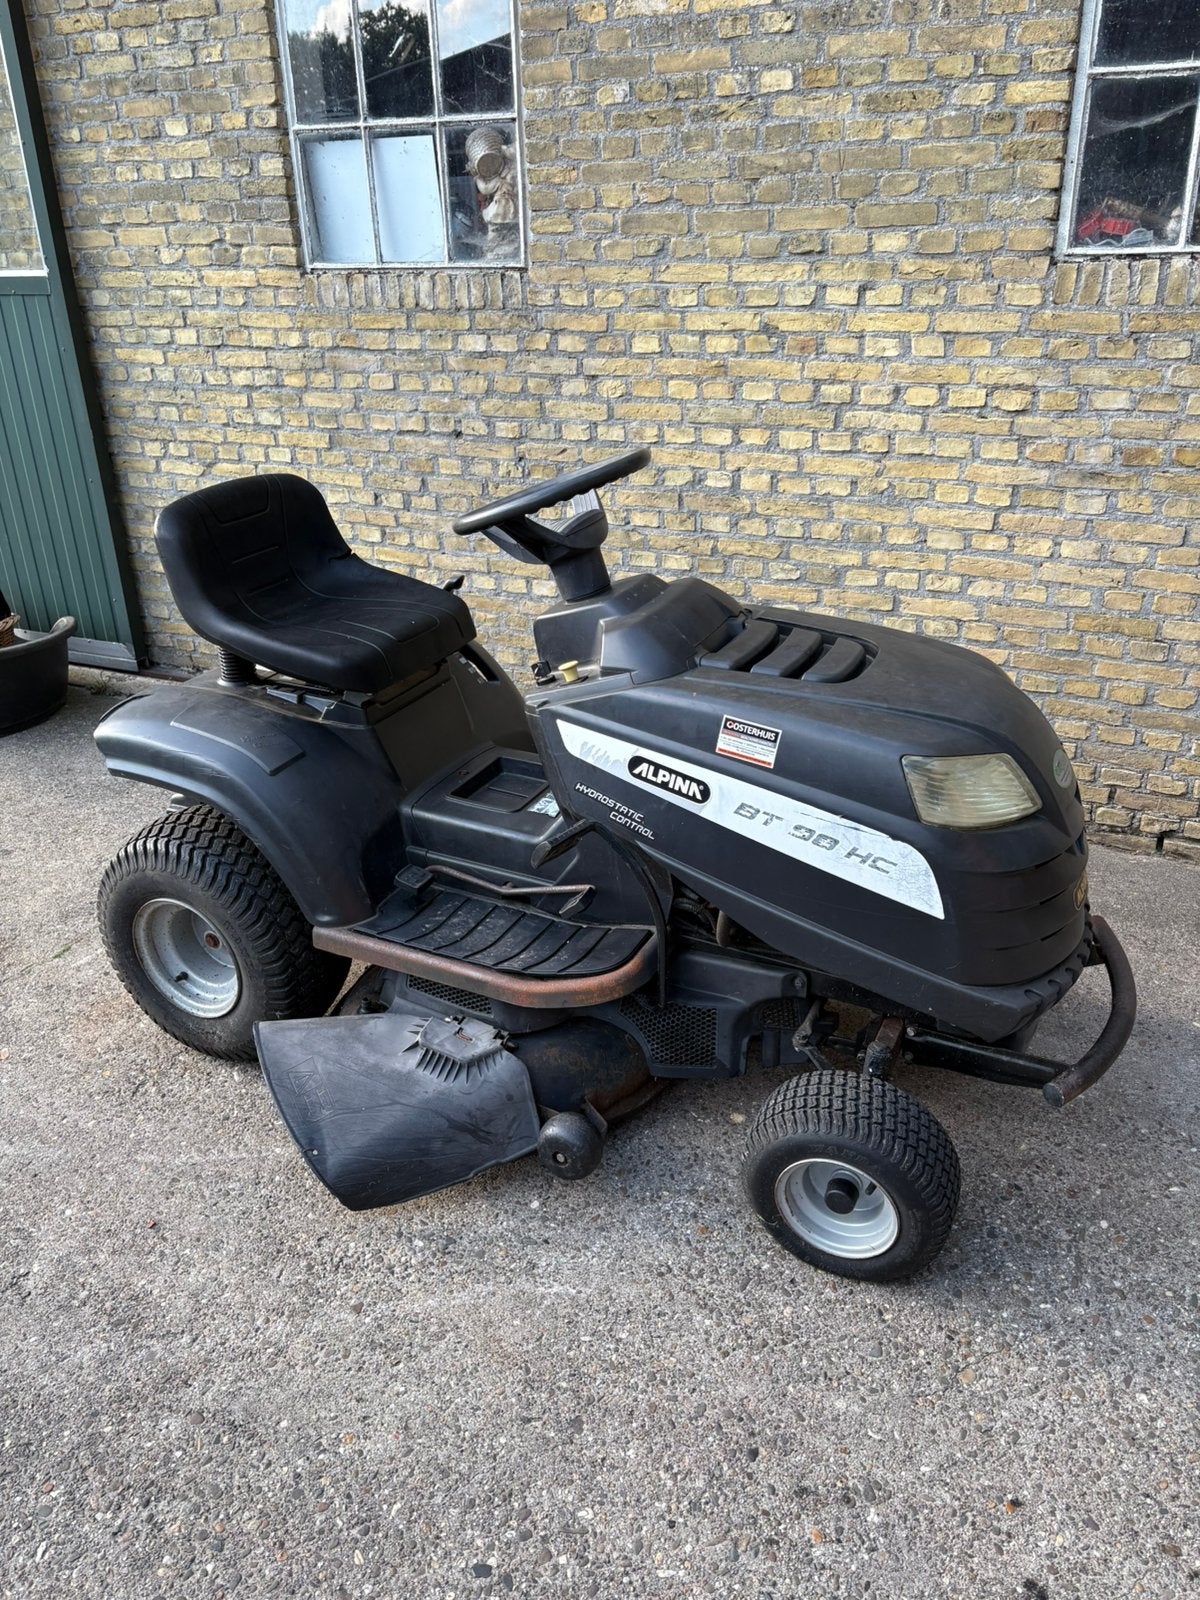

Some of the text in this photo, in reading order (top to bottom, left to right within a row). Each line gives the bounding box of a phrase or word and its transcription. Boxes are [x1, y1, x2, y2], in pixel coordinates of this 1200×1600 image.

[726, 720, 776, 741] OOSTERHUIS
[632, 762, 703, 801] ALPINA
[575, 782, 645, 822] HYDROSTATIC
[609, 811, 655, 840] CONTROL
[733, 802, 898, 874] BT 98 HC
